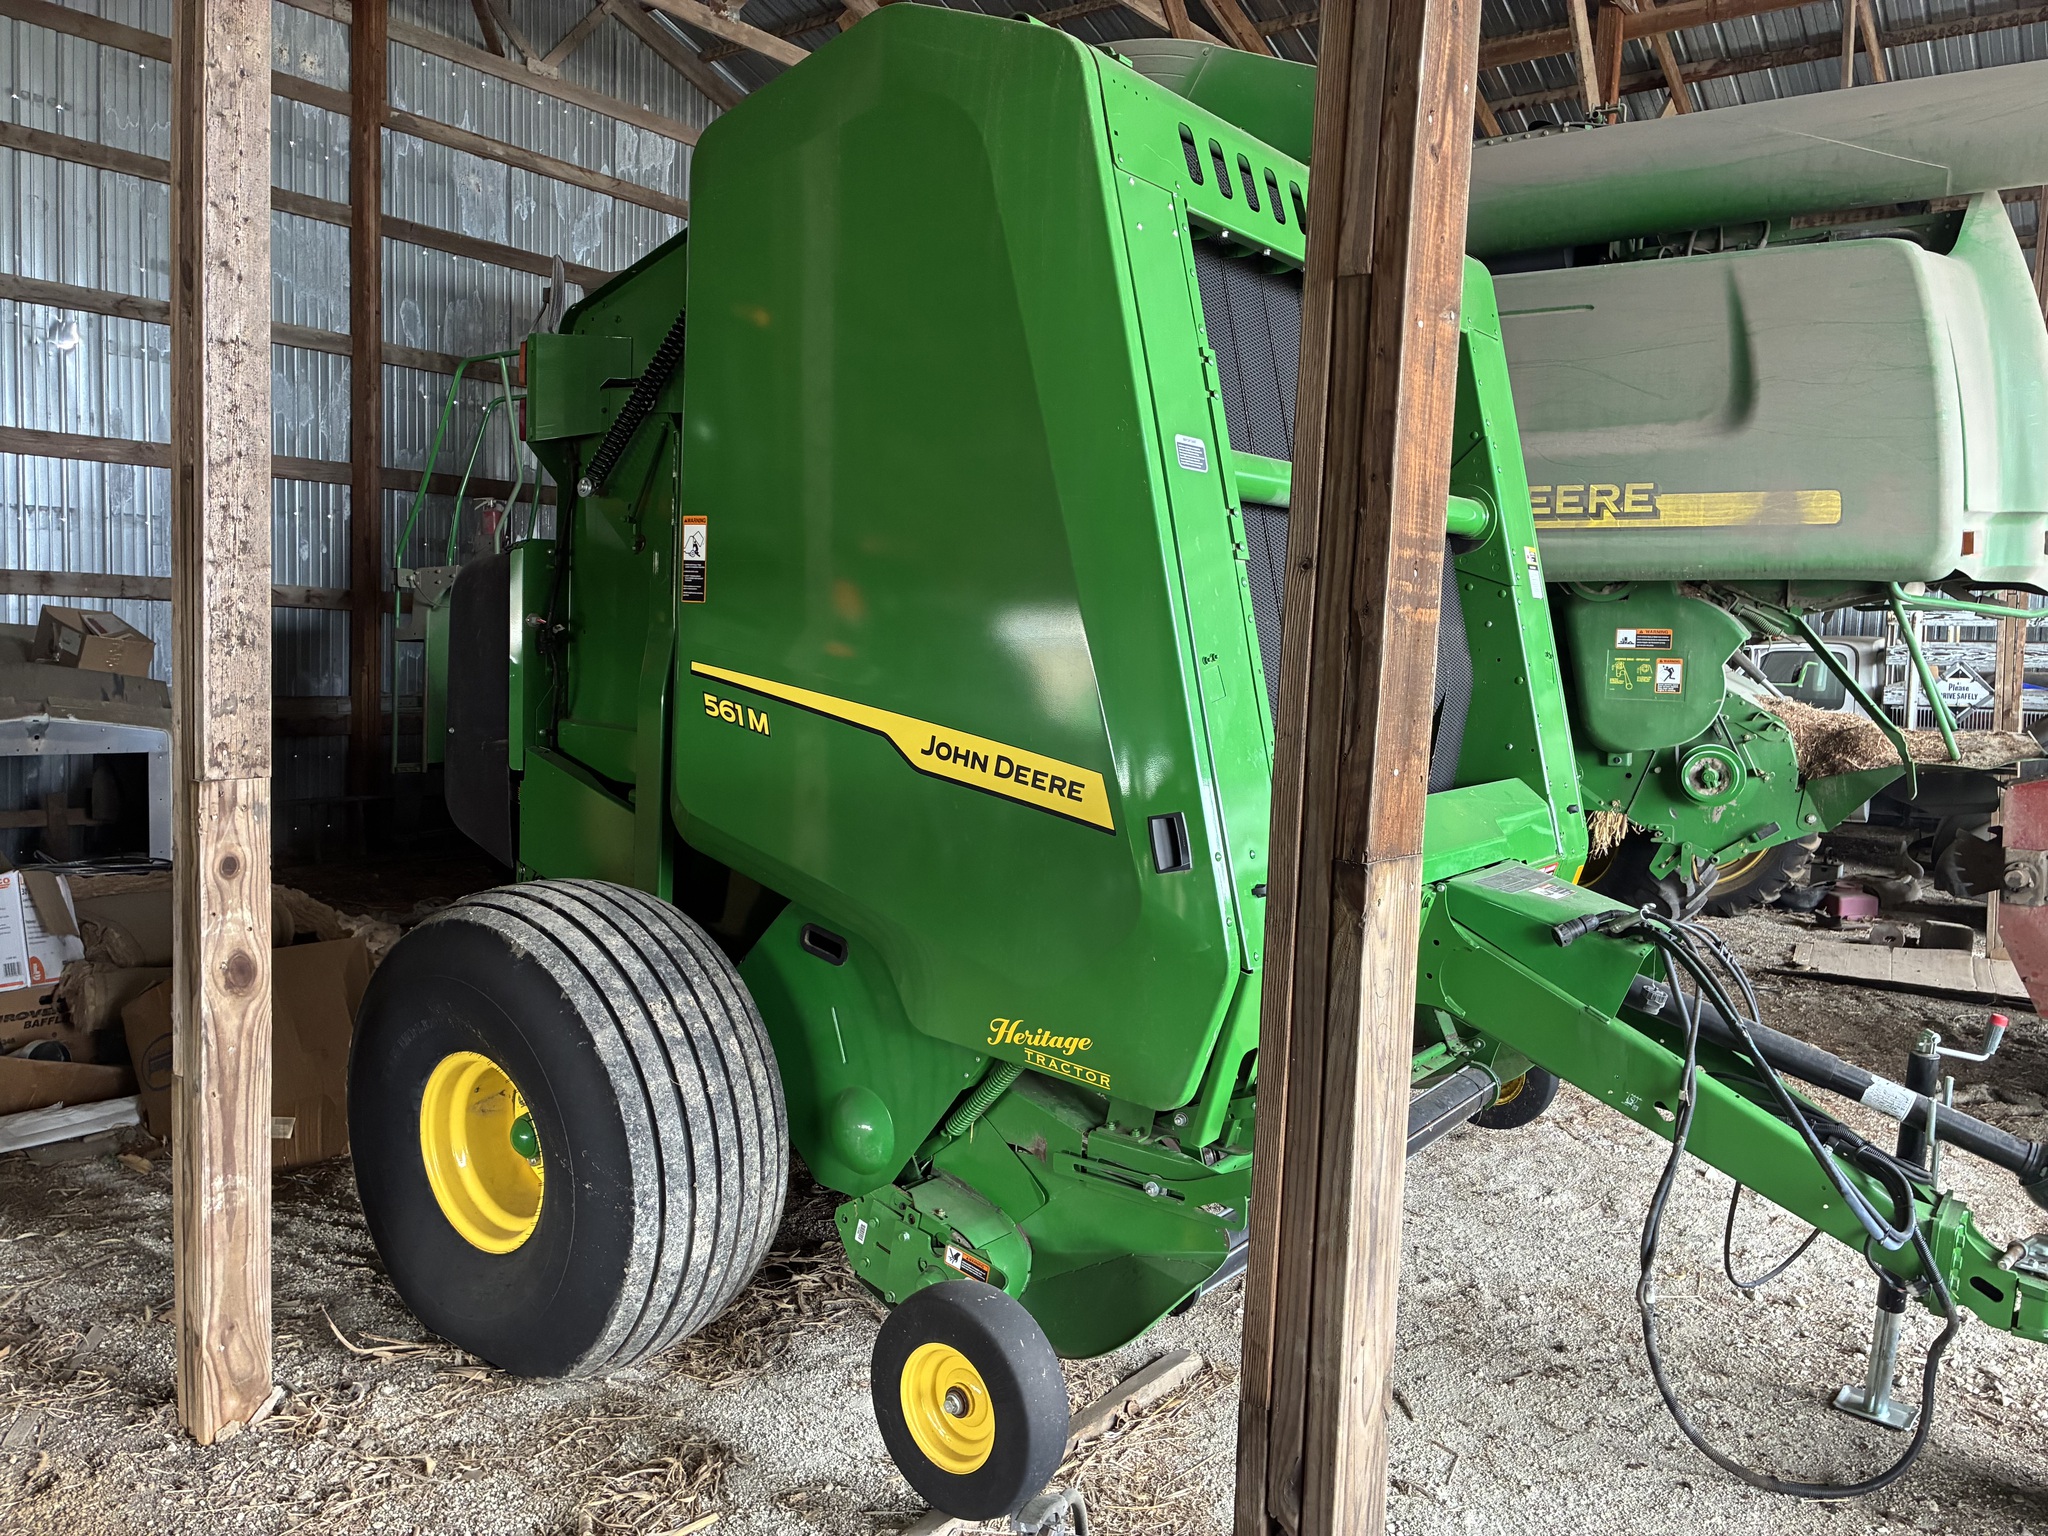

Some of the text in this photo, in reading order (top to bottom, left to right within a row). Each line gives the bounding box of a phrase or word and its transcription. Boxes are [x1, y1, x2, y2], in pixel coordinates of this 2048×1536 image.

[1941, 692, 1956, 700] RIVE
[1948, 683, 1970, 692] Please
[703, 693, 771, 735] 561 M
[921, 735, 1085, 802] JOHN DEERE
[987, 1017, 1094, 1056] Heritage
[1024, 1050, 1111, 1087] TRACTOR
